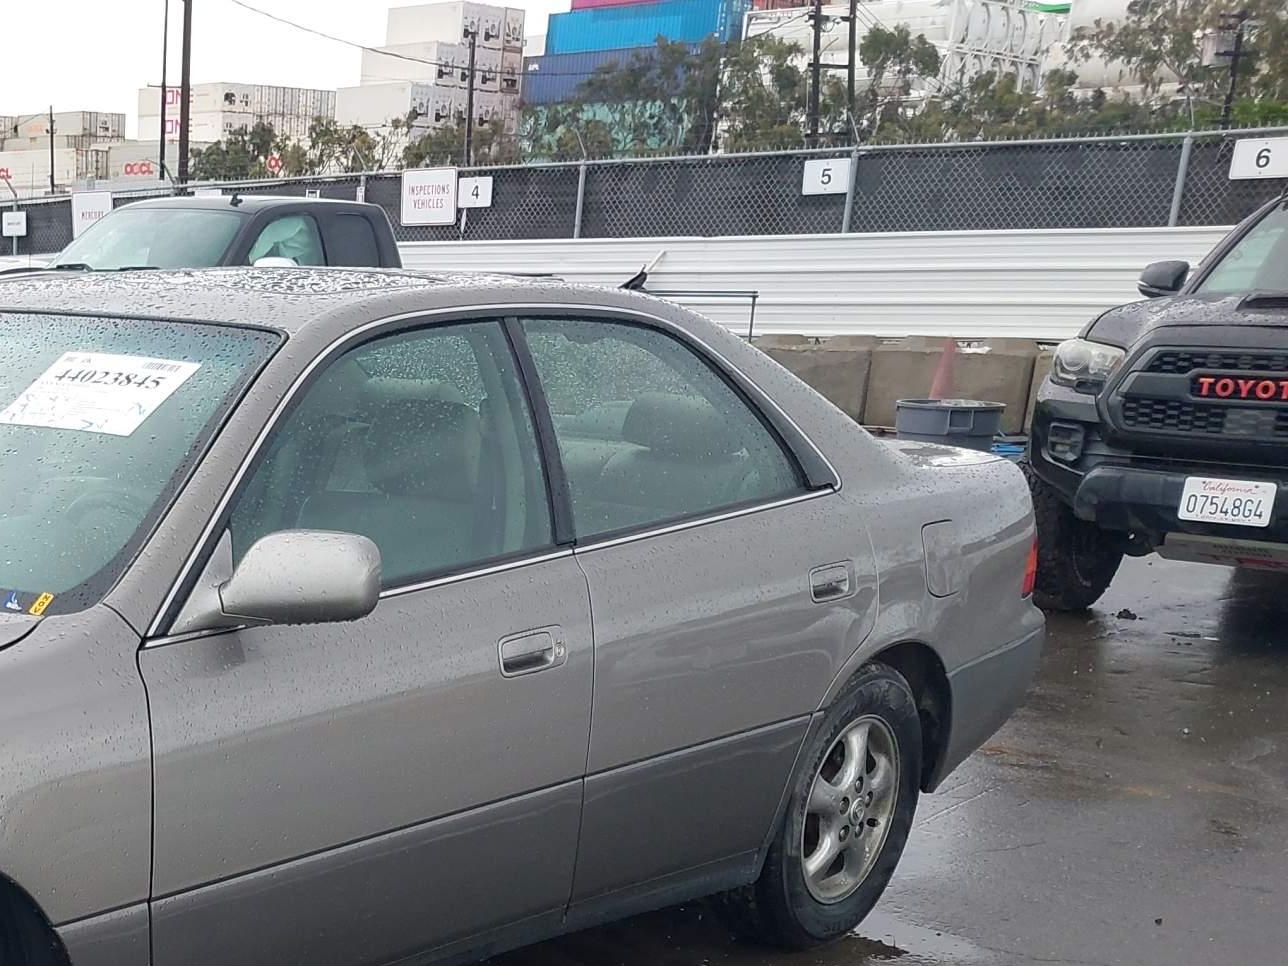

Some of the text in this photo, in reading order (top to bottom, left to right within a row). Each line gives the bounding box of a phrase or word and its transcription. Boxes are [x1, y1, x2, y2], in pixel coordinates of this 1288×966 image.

[1255, 148, 1271, 168] 6
[821, 168, 832, 185] 5
[408, 184, 451, 196] INSPECTIONS
[472, 185, 480, 200] 4
[413, 198, 444, 209] VEHICLES
[54, 368, 167, 390] 44023845
[1203, 480, 1257, 495] California
[1185, 493, 1264, 520] 07548G4
